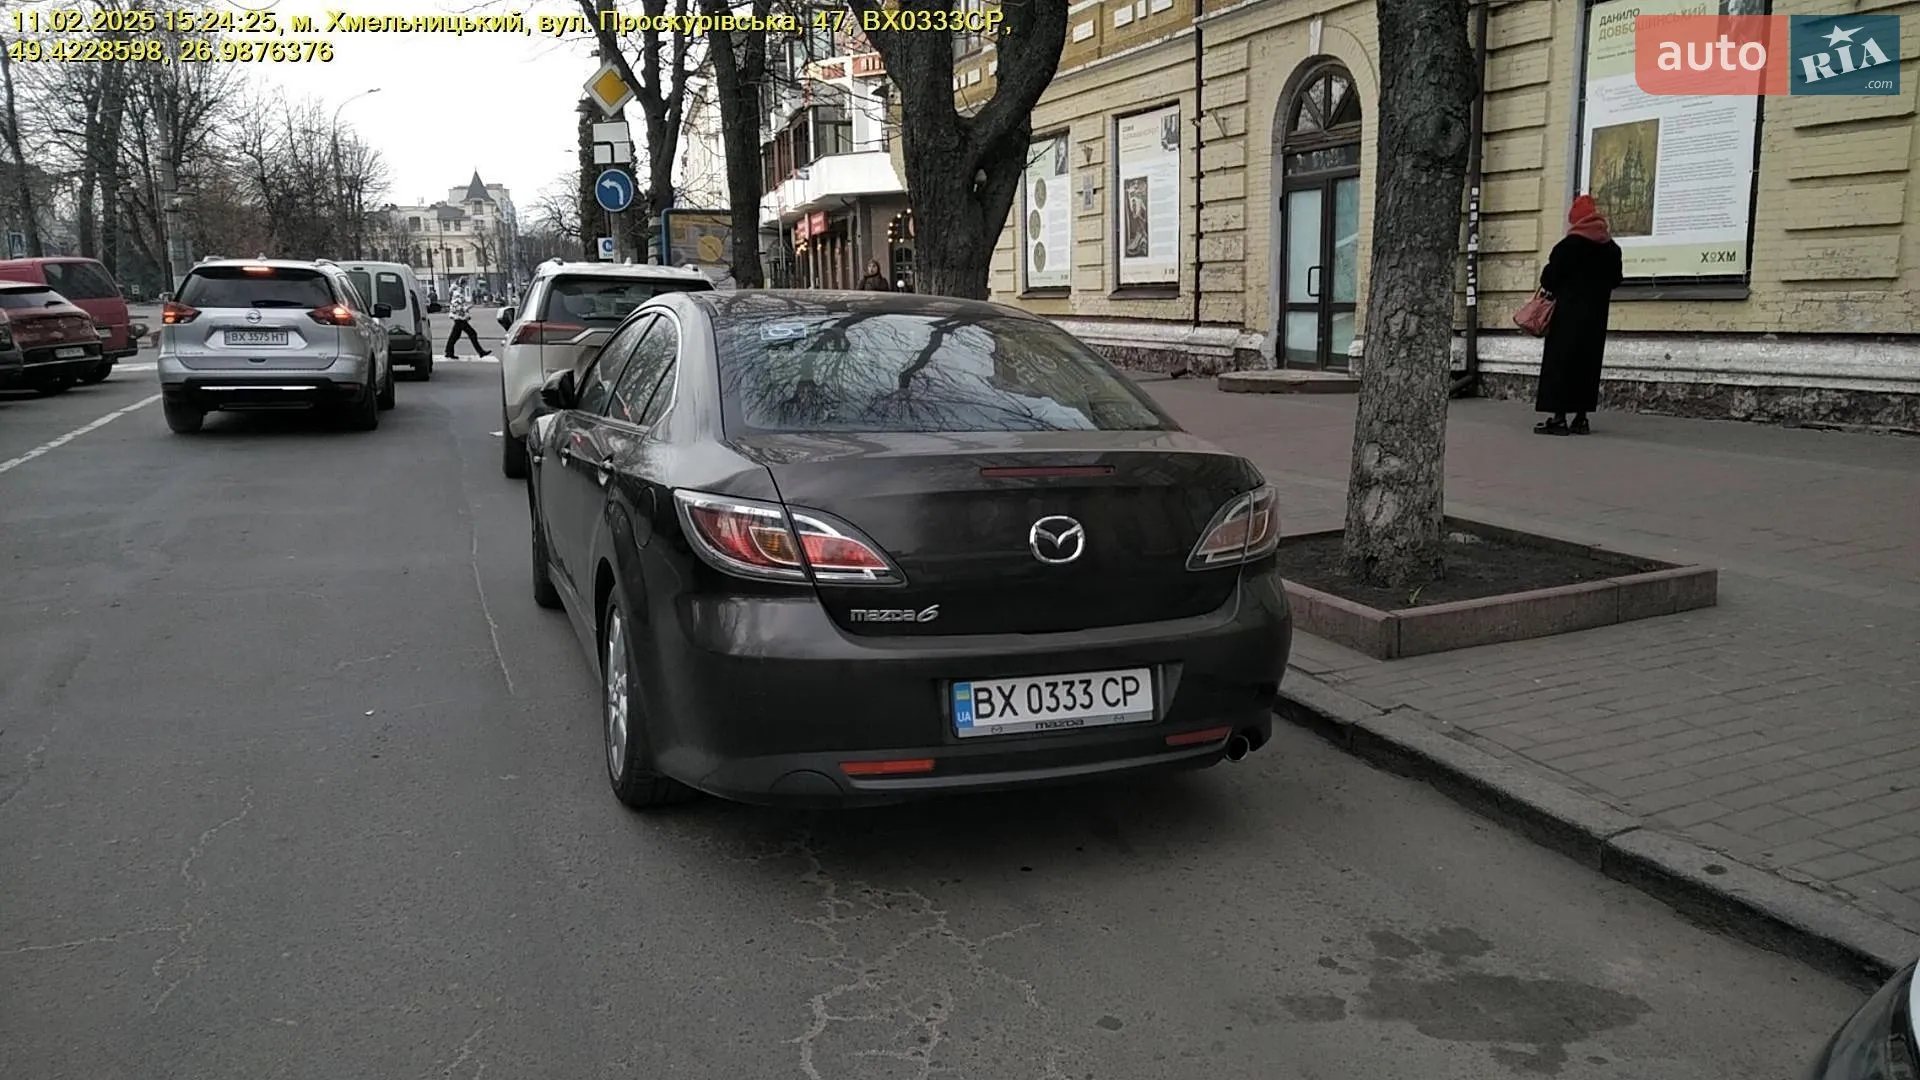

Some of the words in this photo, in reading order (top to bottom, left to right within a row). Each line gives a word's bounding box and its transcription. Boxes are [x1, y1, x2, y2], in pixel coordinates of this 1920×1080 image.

[1599, 8, 1640, 27] ДАНИЛО
[231, 332, 246, 341] BX
[248, 332, 270, 341] 3575
[271, 331, 285, 342] HT
[974, 685, 1019, 720] BX
[1026, 679, 1094, 714] 0333
[1101, 676, 1140, 707] CP
[957, 712, 971, 723] UA
[1035, 719, 1085, 730] mazda
